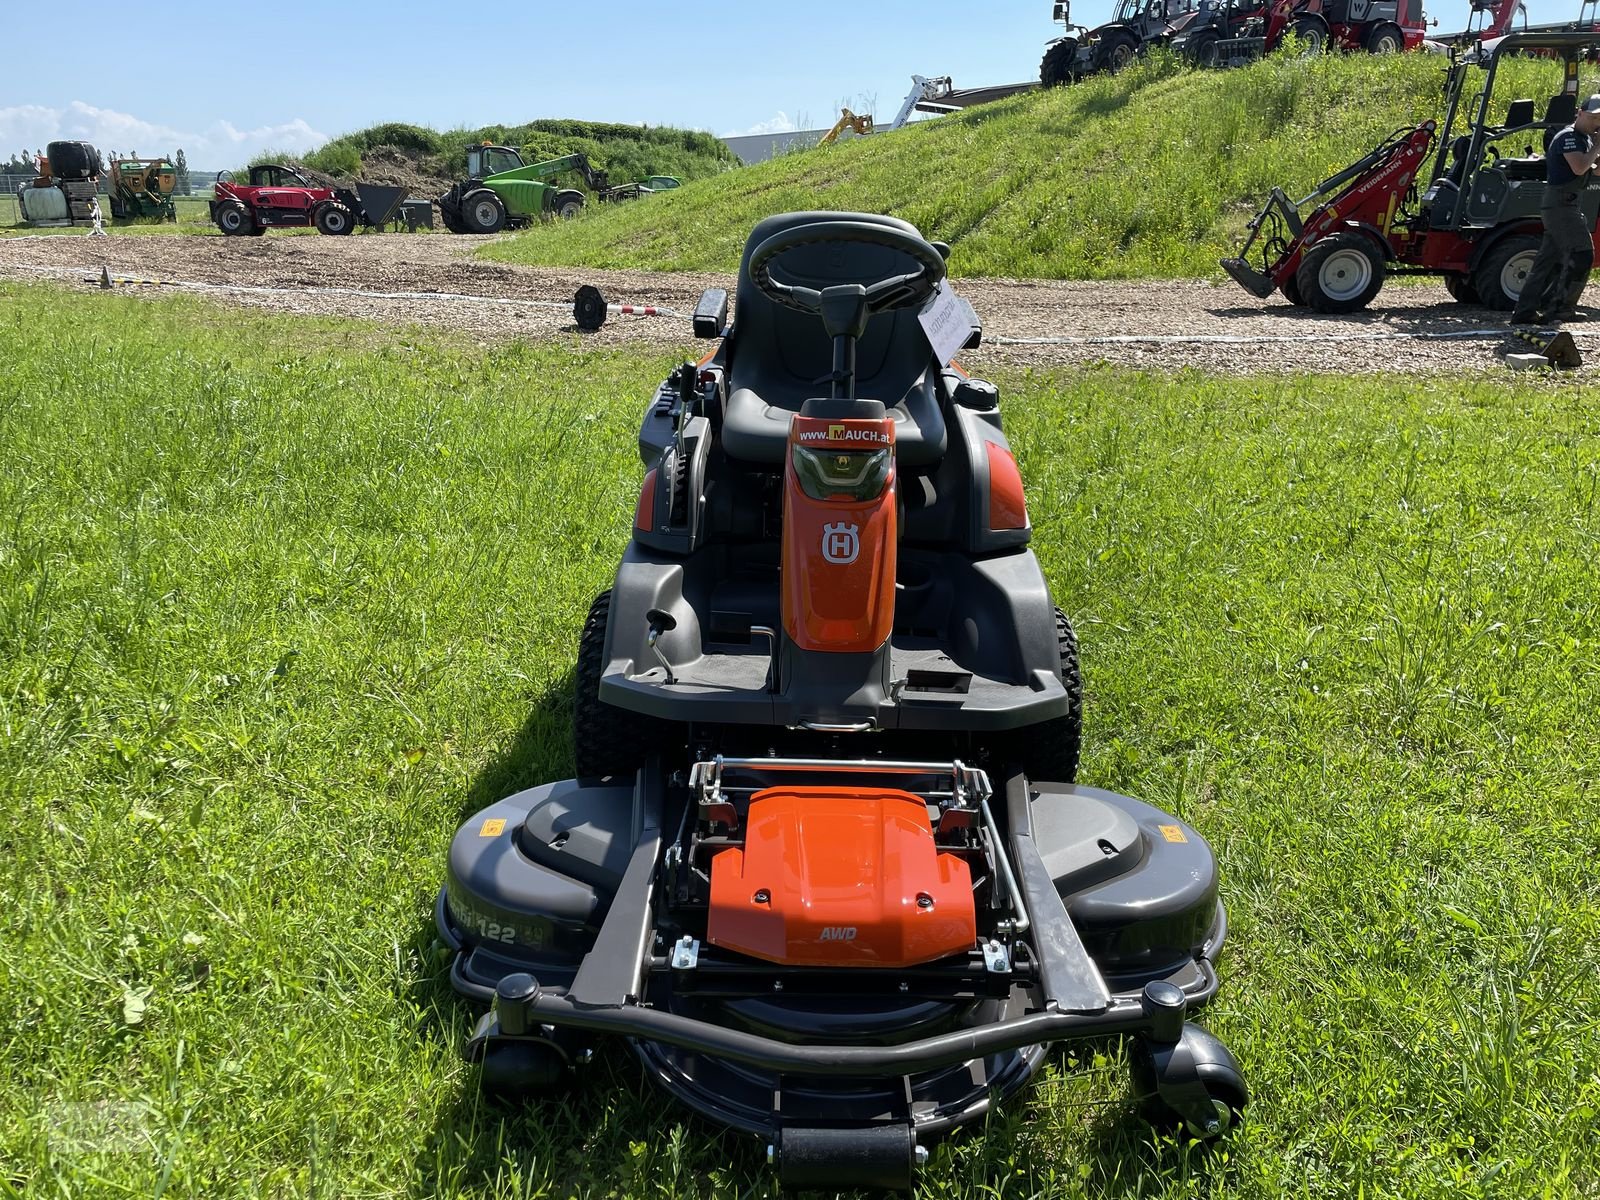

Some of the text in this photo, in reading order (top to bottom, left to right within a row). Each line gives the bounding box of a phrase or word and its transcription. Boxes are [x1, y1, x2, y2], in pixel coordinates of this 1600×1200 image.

[1354, 3, 1363, 12] W
[1358, 160, 1403, 194] WEIDEMANN
[799, 428, 890, 444] www.MAUCH.at
[831, 535, 850, 556] H
[477, 919, 516, 944] 122
[820, 927, 857, 940] AWD
